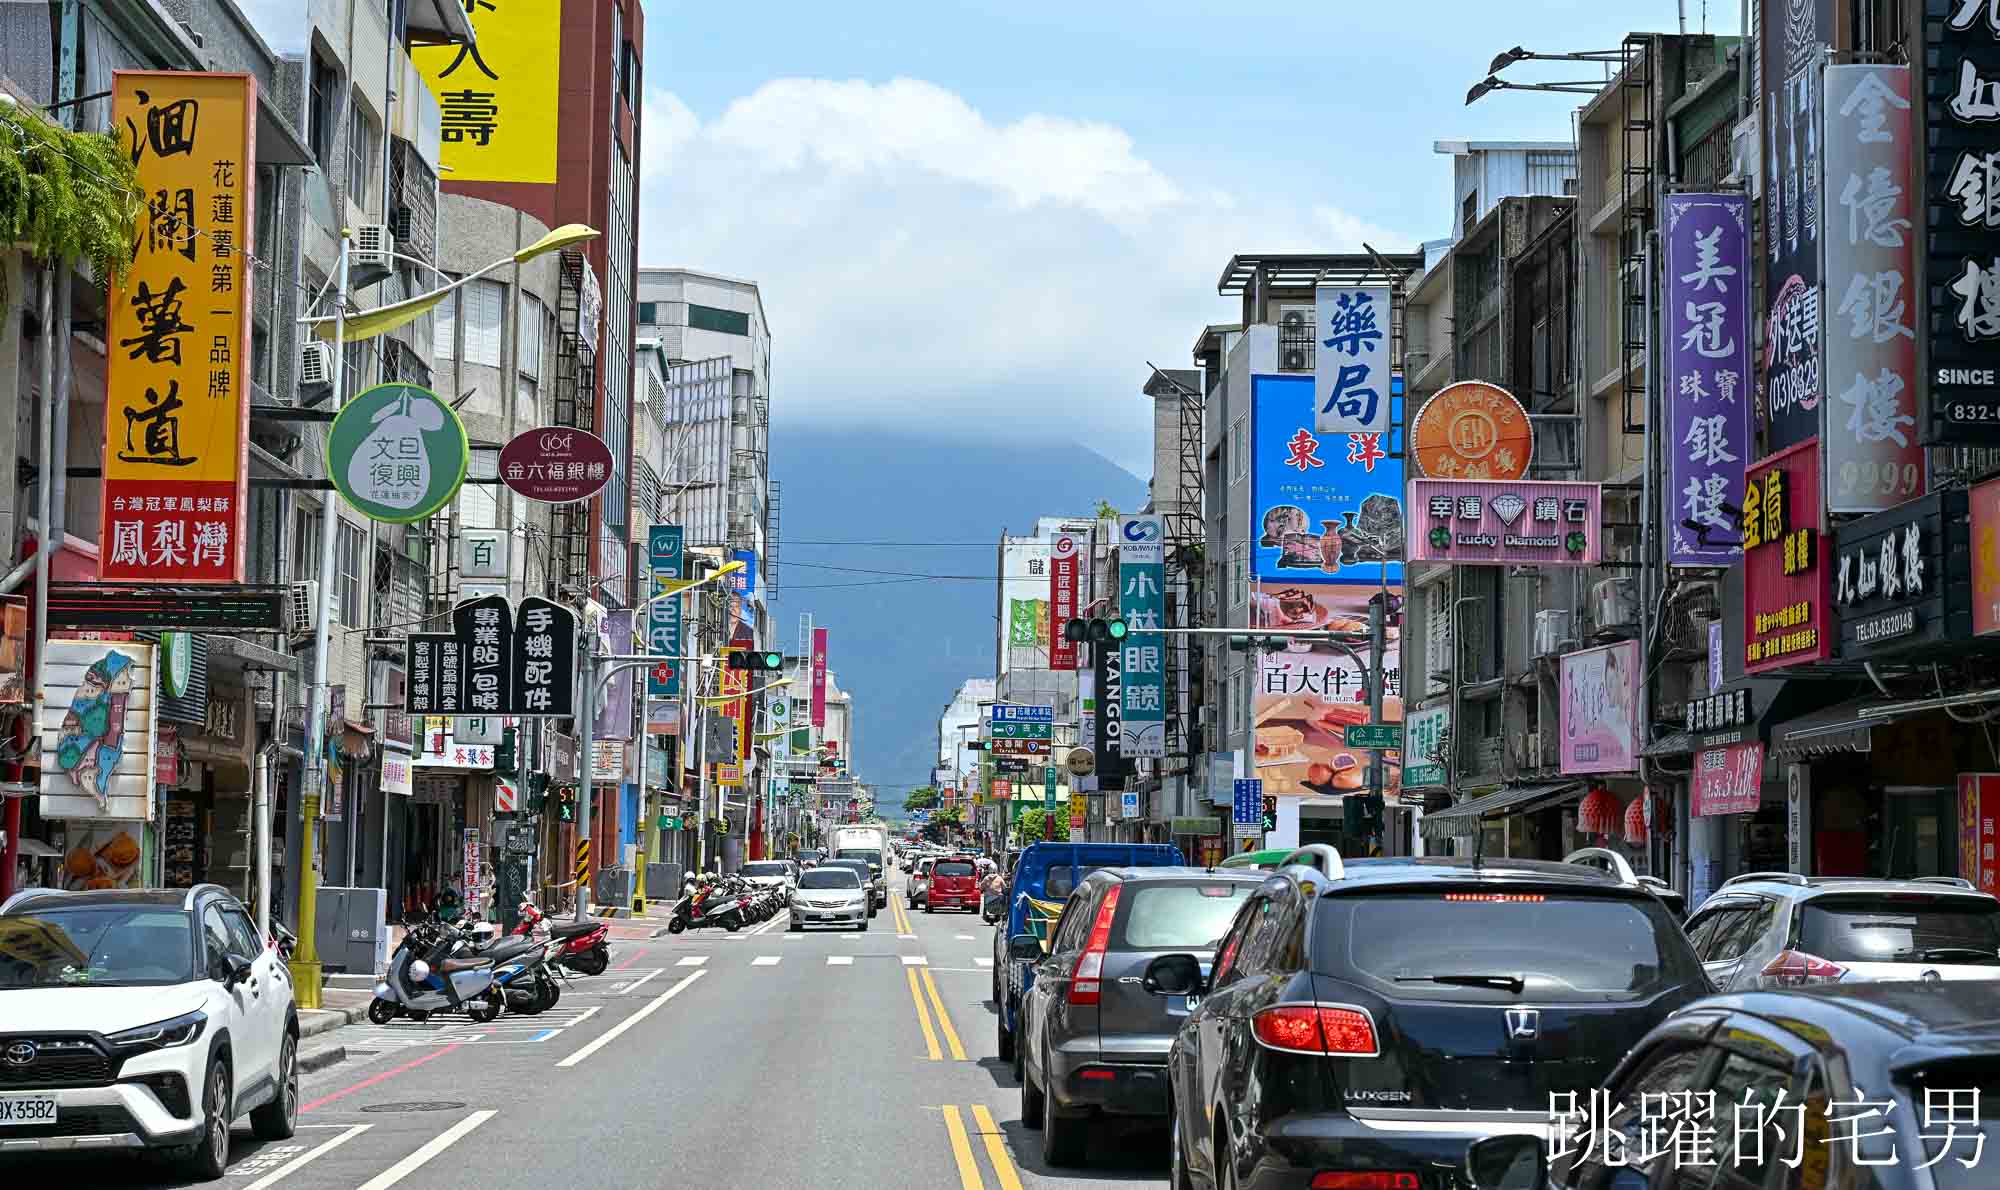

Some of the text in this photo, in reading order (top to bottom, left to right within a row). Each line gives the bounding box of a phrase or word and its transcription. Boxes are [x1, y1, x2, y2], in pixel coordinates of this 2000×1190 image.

[438, 0, 499, 146] 人壽
[207, 159, 235, 400] 花蓮薯第一品牌
[1838, 71, 1914, 449] 金億銀樓
[1680, 225, 1737, 358] 美冠
[1322, 291, 1383, 427] 藥局
[1938, 369, 1994, 385] SINCE
[1679, 369, 1740, 404] 珠寶
[370, 436, 421, 460] 文旦
[507, 461, 605, 480] 金六福銀樓
[1285, 429, 1385, 473] 東洋
[370, 463, 421, 487] 復興
[1681, 414, 1739, 532] 銀樓
[112, 496, 229, 512] 台灣冠軍鳳梨酥
[1430, 496, 1586, 522] 幸運 鑽石
[1744, 469, 1782, 550] 金億
[110, 519, 229, 567] 鳳梨灣
[470, 538, 496, 567] 百
[1457, 533, 1560, 548] Lucky Diamond
[1125, 571, 1159, 711] 小林眼鏡
[1856, 608, 1914, 641] TEL:03-8320148
[414, 642, 430, 710] 客製手機殼
[442, 642, 458, 710] 型號最齊全
[525, 608, 553, 711] 手機配件
[1106, 651, 1121, 752] KANGOL
[560, 787, 574, 802] 57
[1344, 1088, 1411, 1101] LUXGEN
